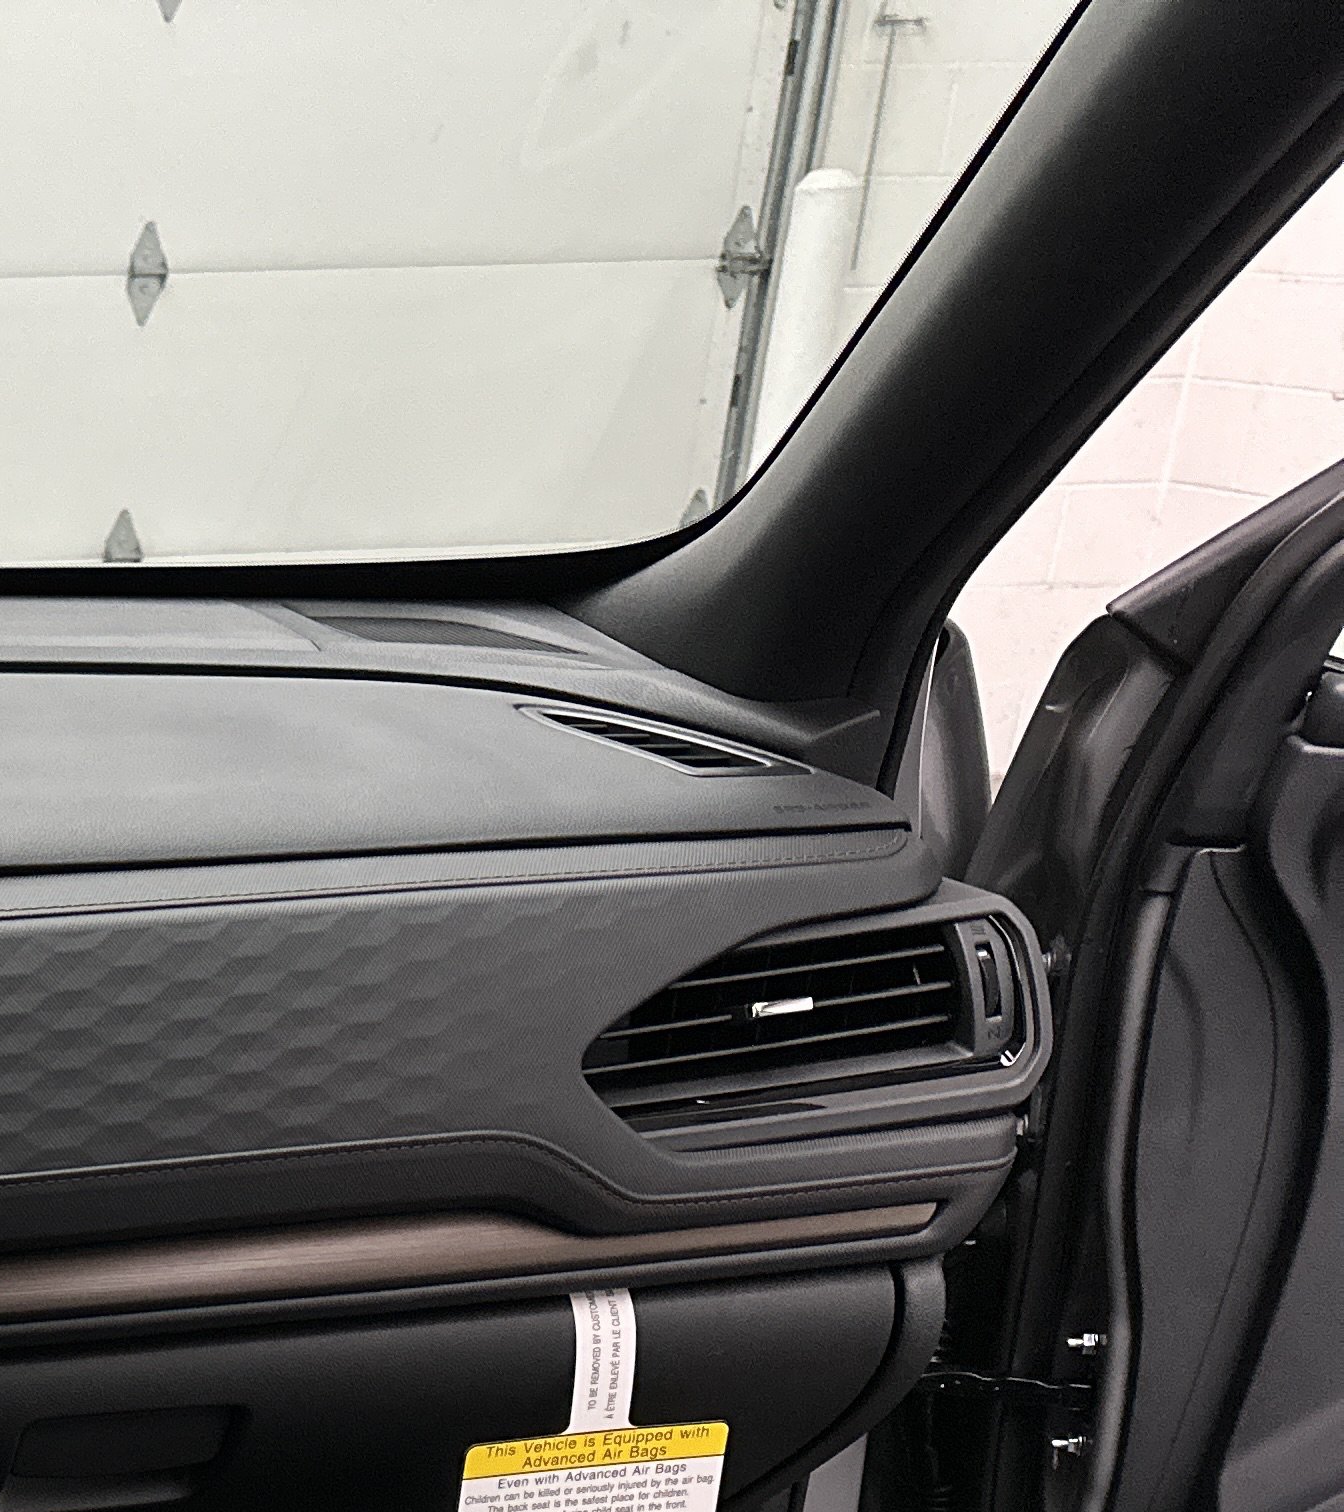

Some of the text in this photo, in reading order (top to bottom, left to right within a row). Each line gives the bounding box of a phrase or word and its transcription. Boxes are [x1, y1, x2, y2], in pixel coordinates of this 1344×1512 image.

[608, 1300, 620, 1326] CLIENT
[593, 1334, 601, 1344] BY
[612, 1330, 620, 1339] LE
[612, 1342, 620, 1357] PAR
[590, 1347, 601, 1385] REMOVED
[589, 1388, 598, 1397] BE
[587, 1400, 596, 1410] TO
[486, 1425, 710, 1459] This Vehicle is Equipped with
[521, 1445, 667, 1469] Advanced Air Bags
[497, 1463, 687, 1490] Even with Advanced Air Bags
